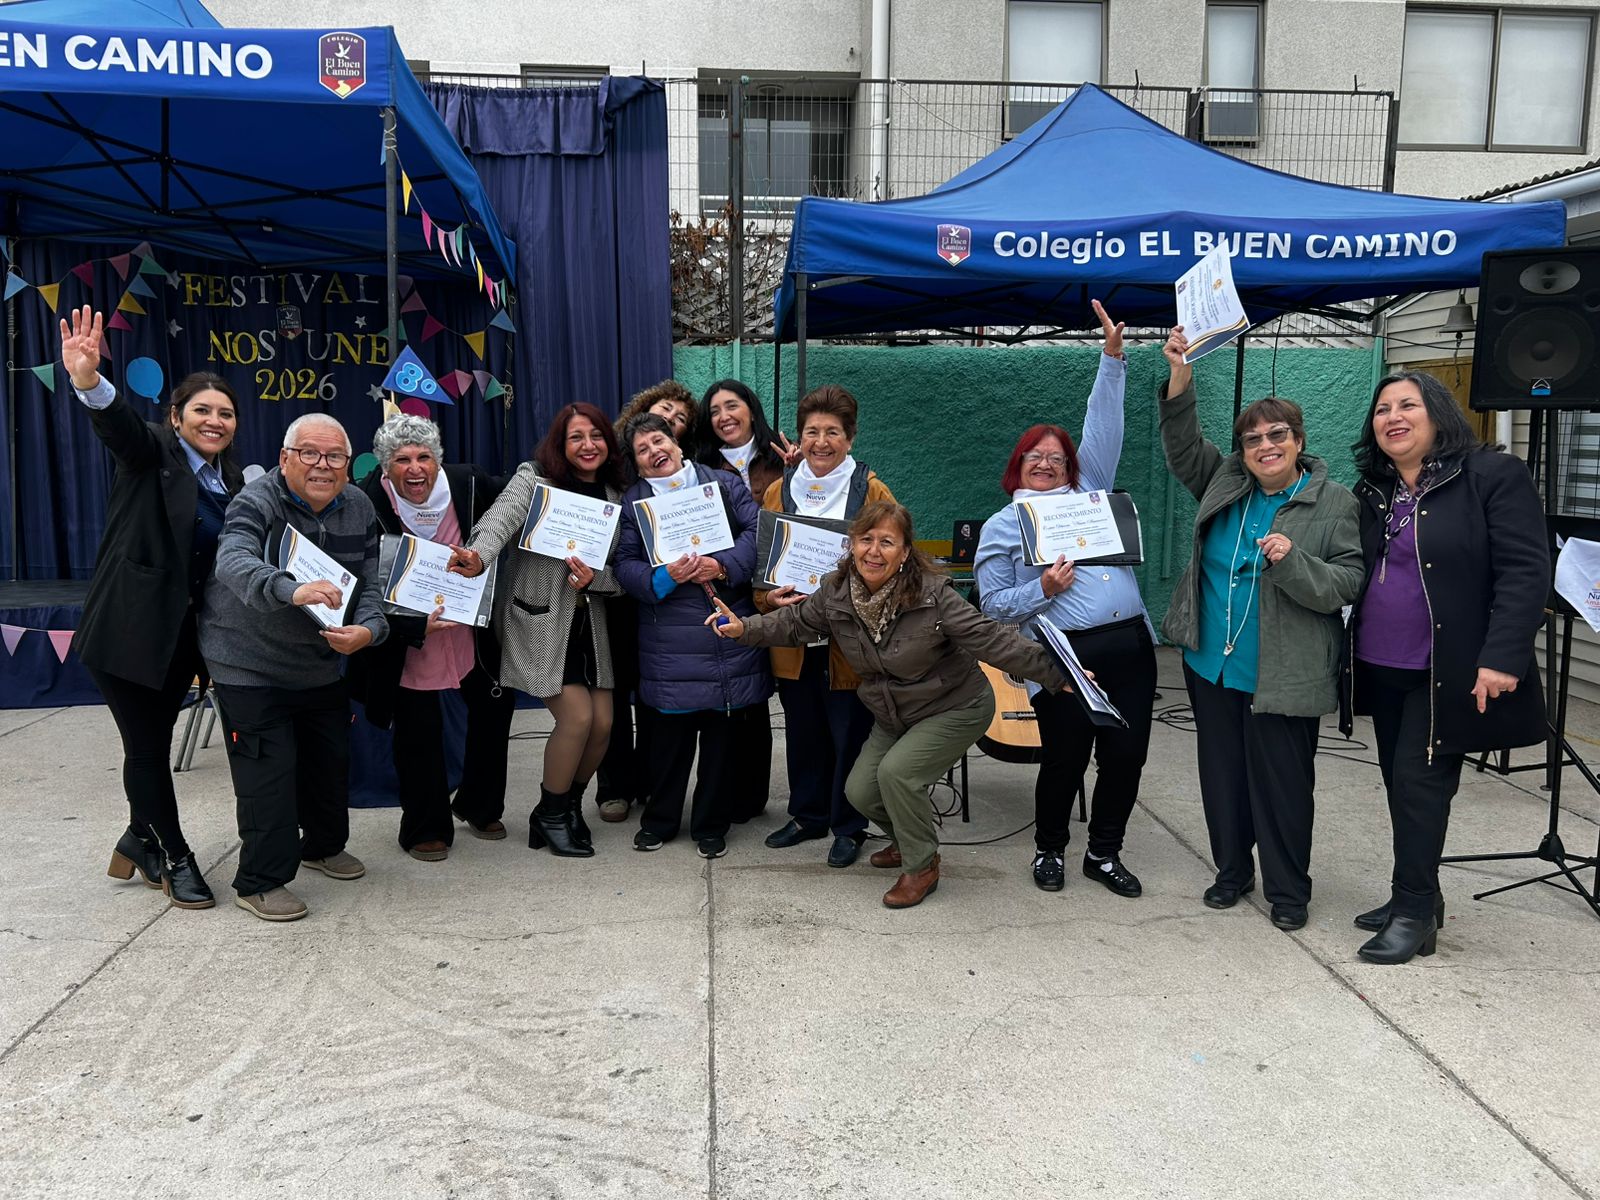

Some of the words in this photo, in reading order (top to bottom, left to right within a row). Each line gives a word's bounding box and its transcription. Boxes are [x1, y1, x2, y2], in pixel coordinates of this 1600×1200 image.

[64, 34, 273, 80] CAMINO
[325, 57, 335, 68] El
[337, 58, 361, 69] Buen
[325, 65, 360, 76] Camino
[993, 230, 1126, 264] Colegio
[1139, 230, 1181, 257] EL
[1193, 231, 1292, 259] BUEN
[1305, 229, 1458, 259] CAMINO
[180, 273, 379, 308] FESTIVAL
[207, 328, 277, 365] NOS
[304, 328, 391, 367] UNE
[255, 368, 338, 402] 2026
[806, 493, 826, 501] Nuevo
[552, 508, 608, 527] RECONOCIMIENTO
[660, 502, 716, 521] RECONOCIMIENTO
[1043, 508, 1103, 521] RECONOCIMIENTO
